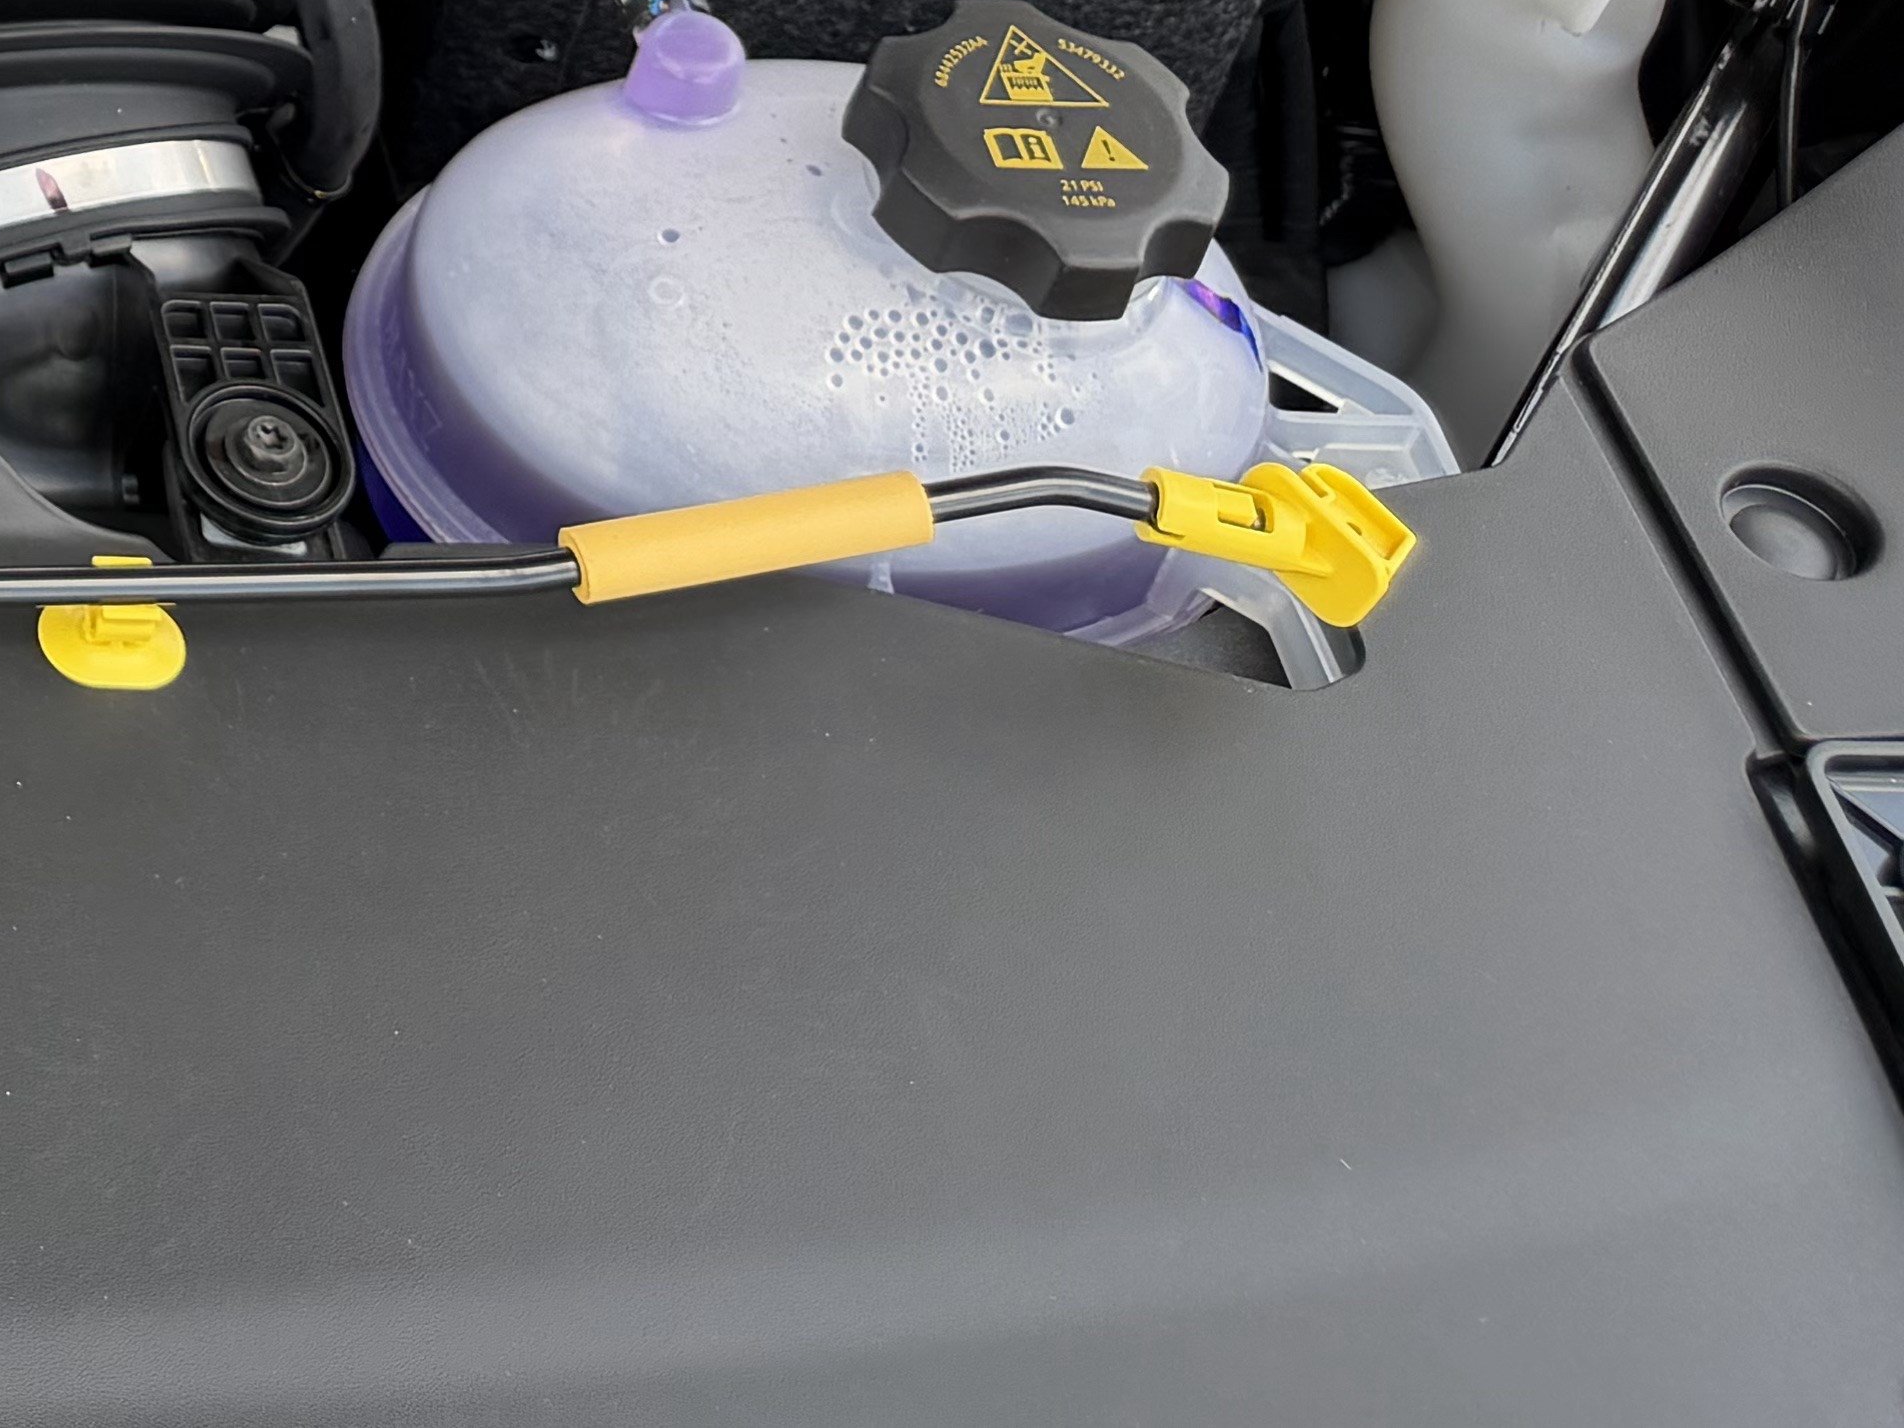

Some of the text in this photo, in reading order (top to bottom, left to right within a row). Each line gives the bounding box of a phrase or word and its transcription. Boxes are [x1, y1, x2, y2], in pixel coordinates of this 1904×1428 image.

[1060, 179, 1105, 192] 21 PSI
[1061, 195, 1117, 208] 145 kPa
